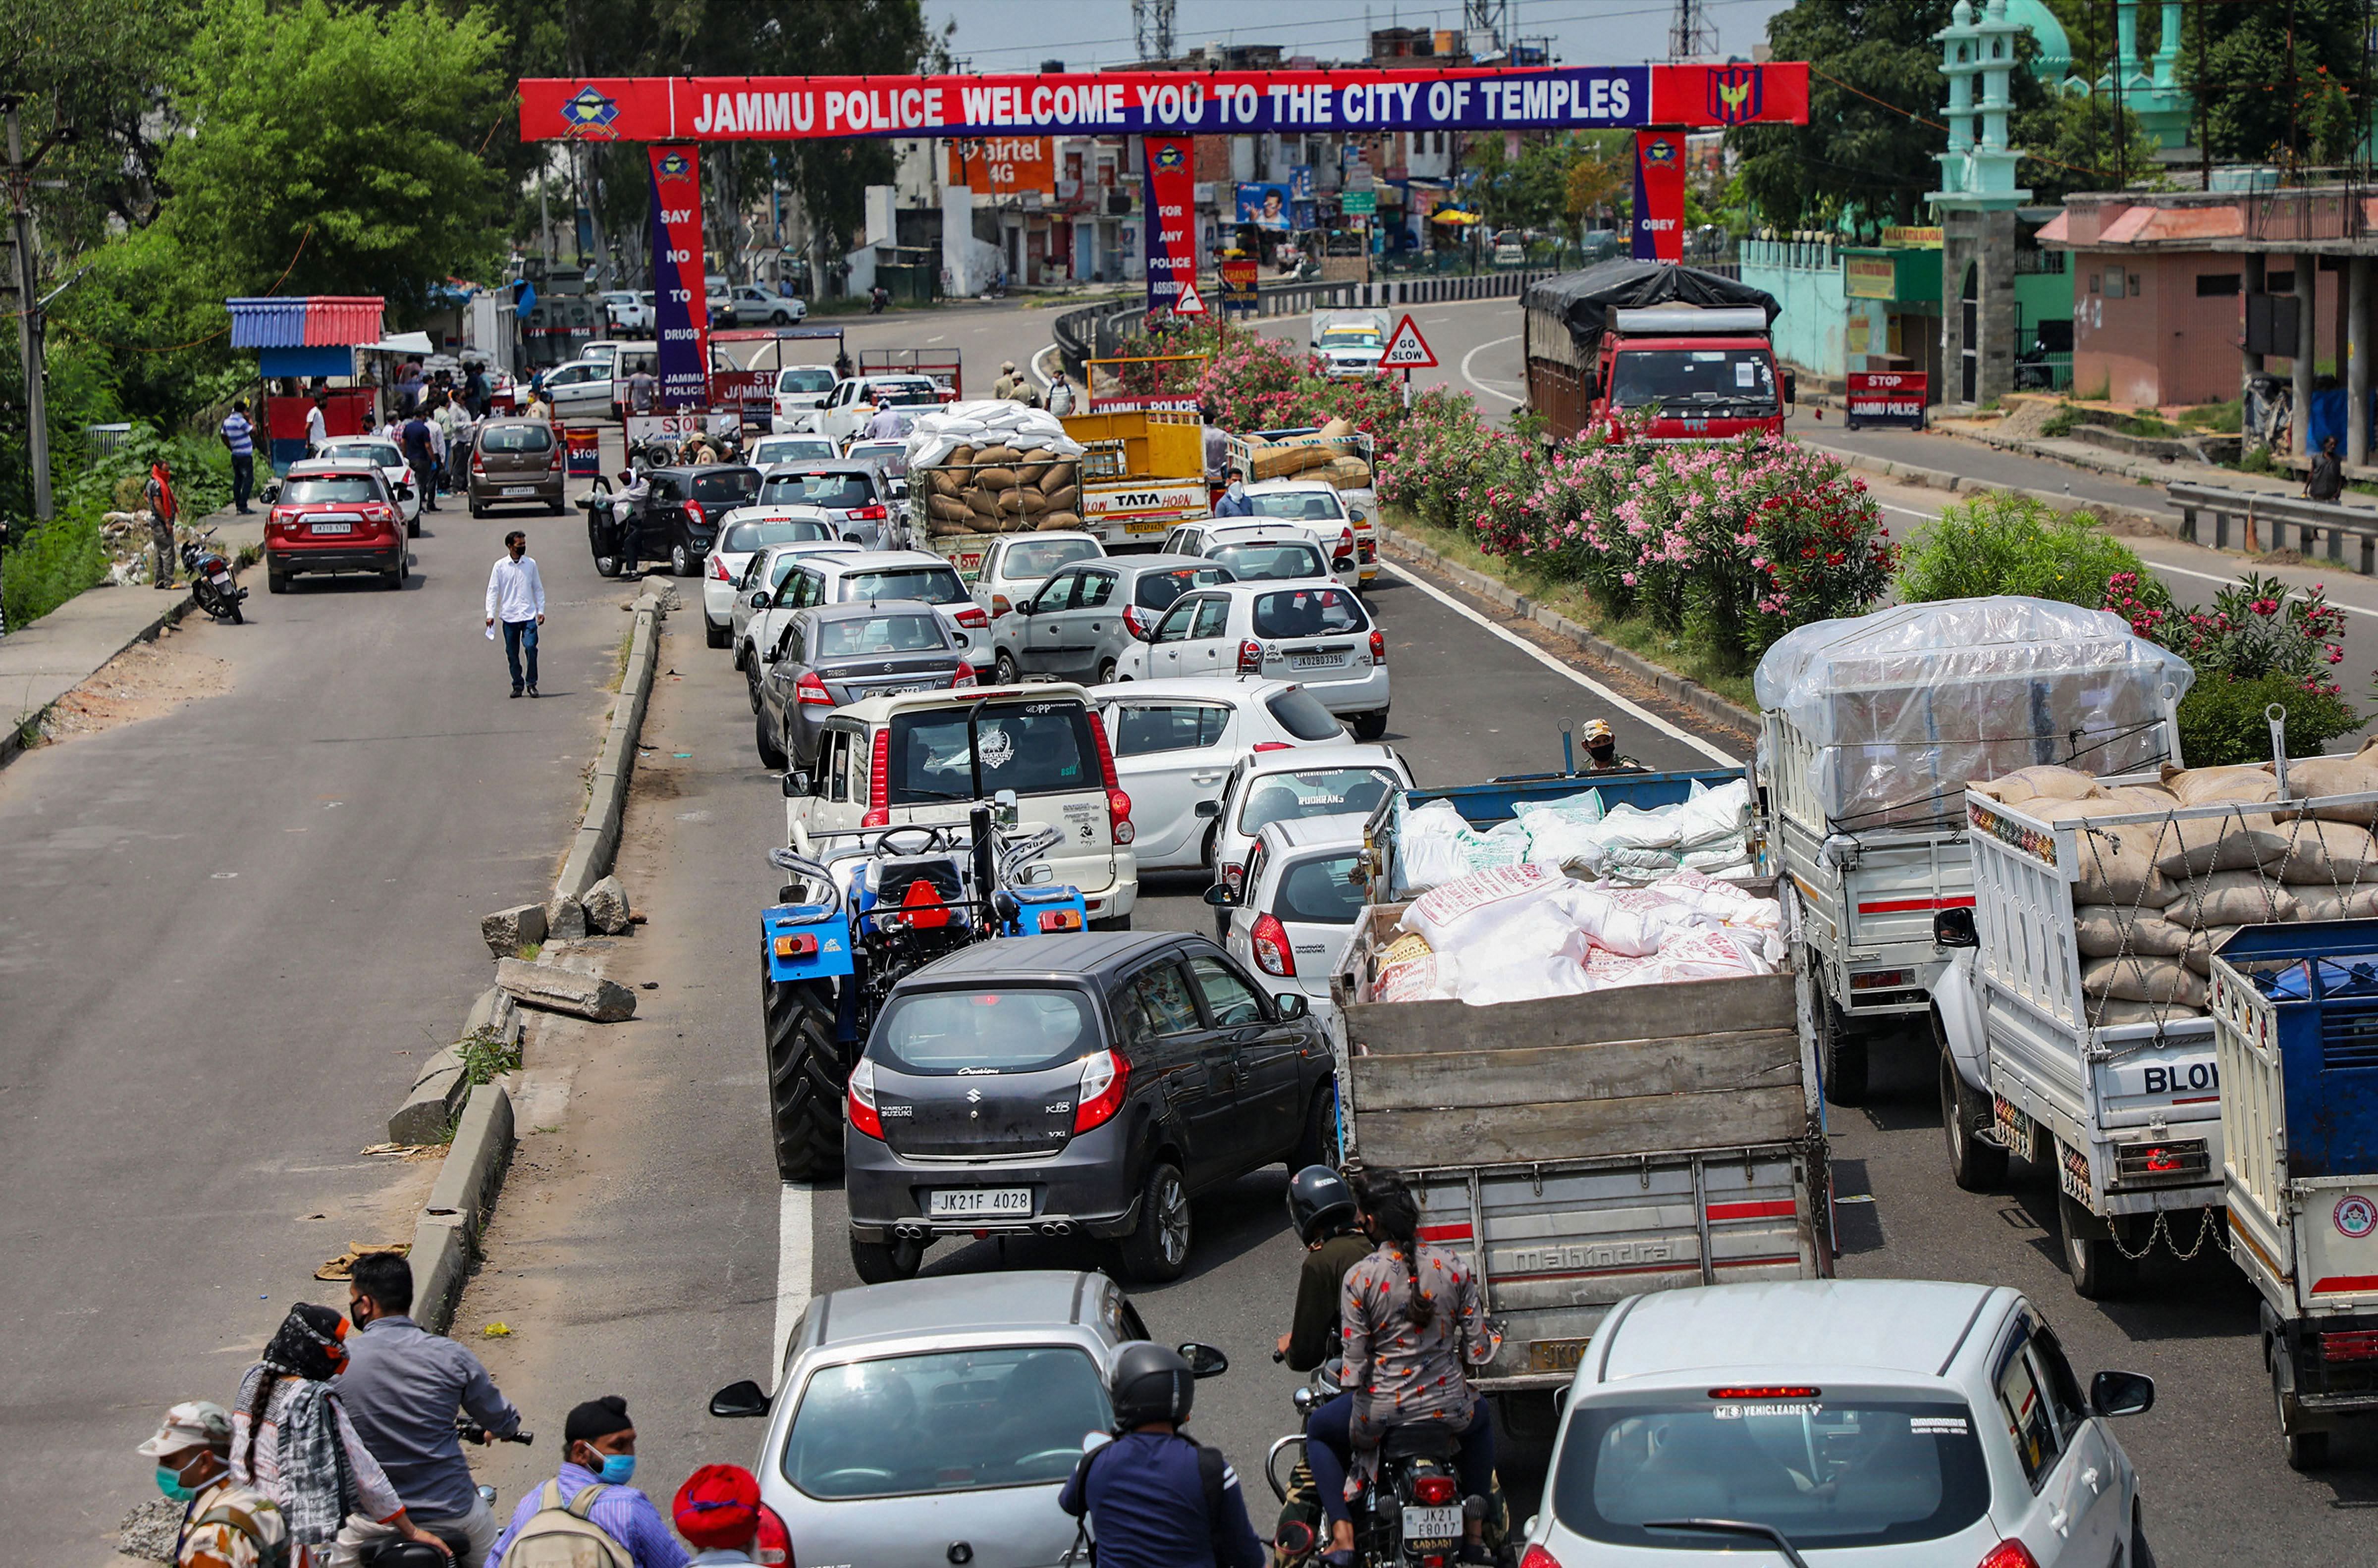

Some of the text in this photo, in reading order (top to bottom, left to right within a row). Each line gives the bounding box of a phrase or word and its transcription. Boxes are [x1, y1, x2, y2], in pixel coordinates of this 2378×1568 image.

[694, 79, 1630, 132] JAMMU POLICE WELCOME YOU TO THE CITY OF TEMPLES
[981, 138, 1042, 161] airtel
[990, 163, 1015, 183] 4G
[660, 209, 692, 224] SAY
[1159, 206, 1182, 216] FOR
[1641, 219, 1675, 230] OBEY
[1159, 231, 1183, 242] ANY
[666, 250, 691, 263] NO
[1150, 257, 1191, 269] POLICE
[669, 290, 692, 302] TO
[664, 328, 700, 340] DRUGS
[1400, 339, 1415, 348] GO
[1392, 351, 1422, 360] SLOW
[665, 373, 705, 384] JAMMU
[1868, 375, 1902, 387] STOP
[665, 385, 705, 396] POLICE
[1150, 399, 1197, 412] POLICE
[1851, 402, 1920, 416] JAMMU POLICE
[572, 448, 598, 459] STOP
[1115, 494, 1159, 506] TATA
[1162, 494, 1192, 508] HORN
[941, 1194, 983, 1209] JK21F
[993, 1194, 1027, 1208] 4028
[1513, 1244, 1673, 1271] mahindra
[1743, 1405, 1807, 1416] VEHICLEADES
[1423, 1509, 1452, 1522] JK21
